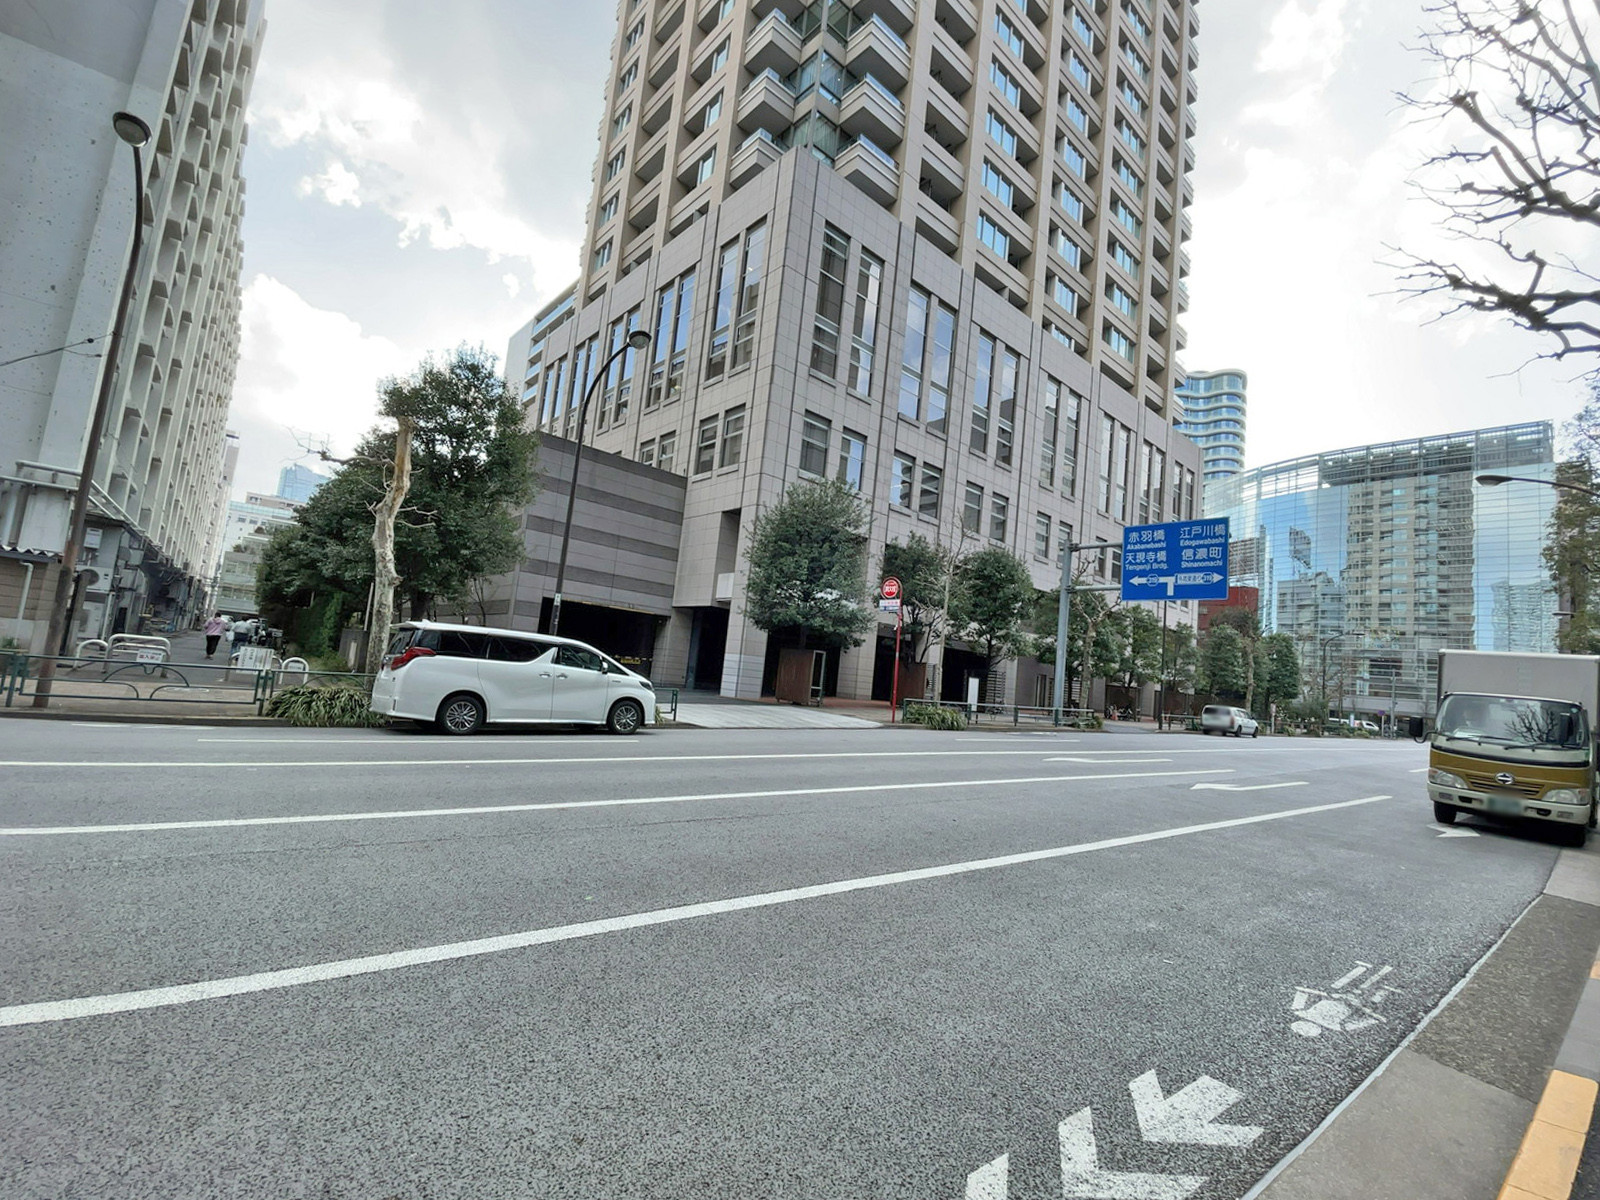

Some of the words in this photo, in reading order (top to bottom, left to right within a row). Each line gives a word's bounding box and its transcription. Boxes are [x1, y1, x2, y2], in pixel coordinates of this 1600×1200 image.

[1129, 530, 1165, 542] 赤羽橋
[1180, 524, 1226, 538] 江戸川橋
[1180, 537, 1225, 547] Edogawabashi
[1125, 550, 1167, 563] 天現寺橋
[1181, 547, 1222, 561] 信濃町
[1181, 560, 1223, 568] Shinanomachi
